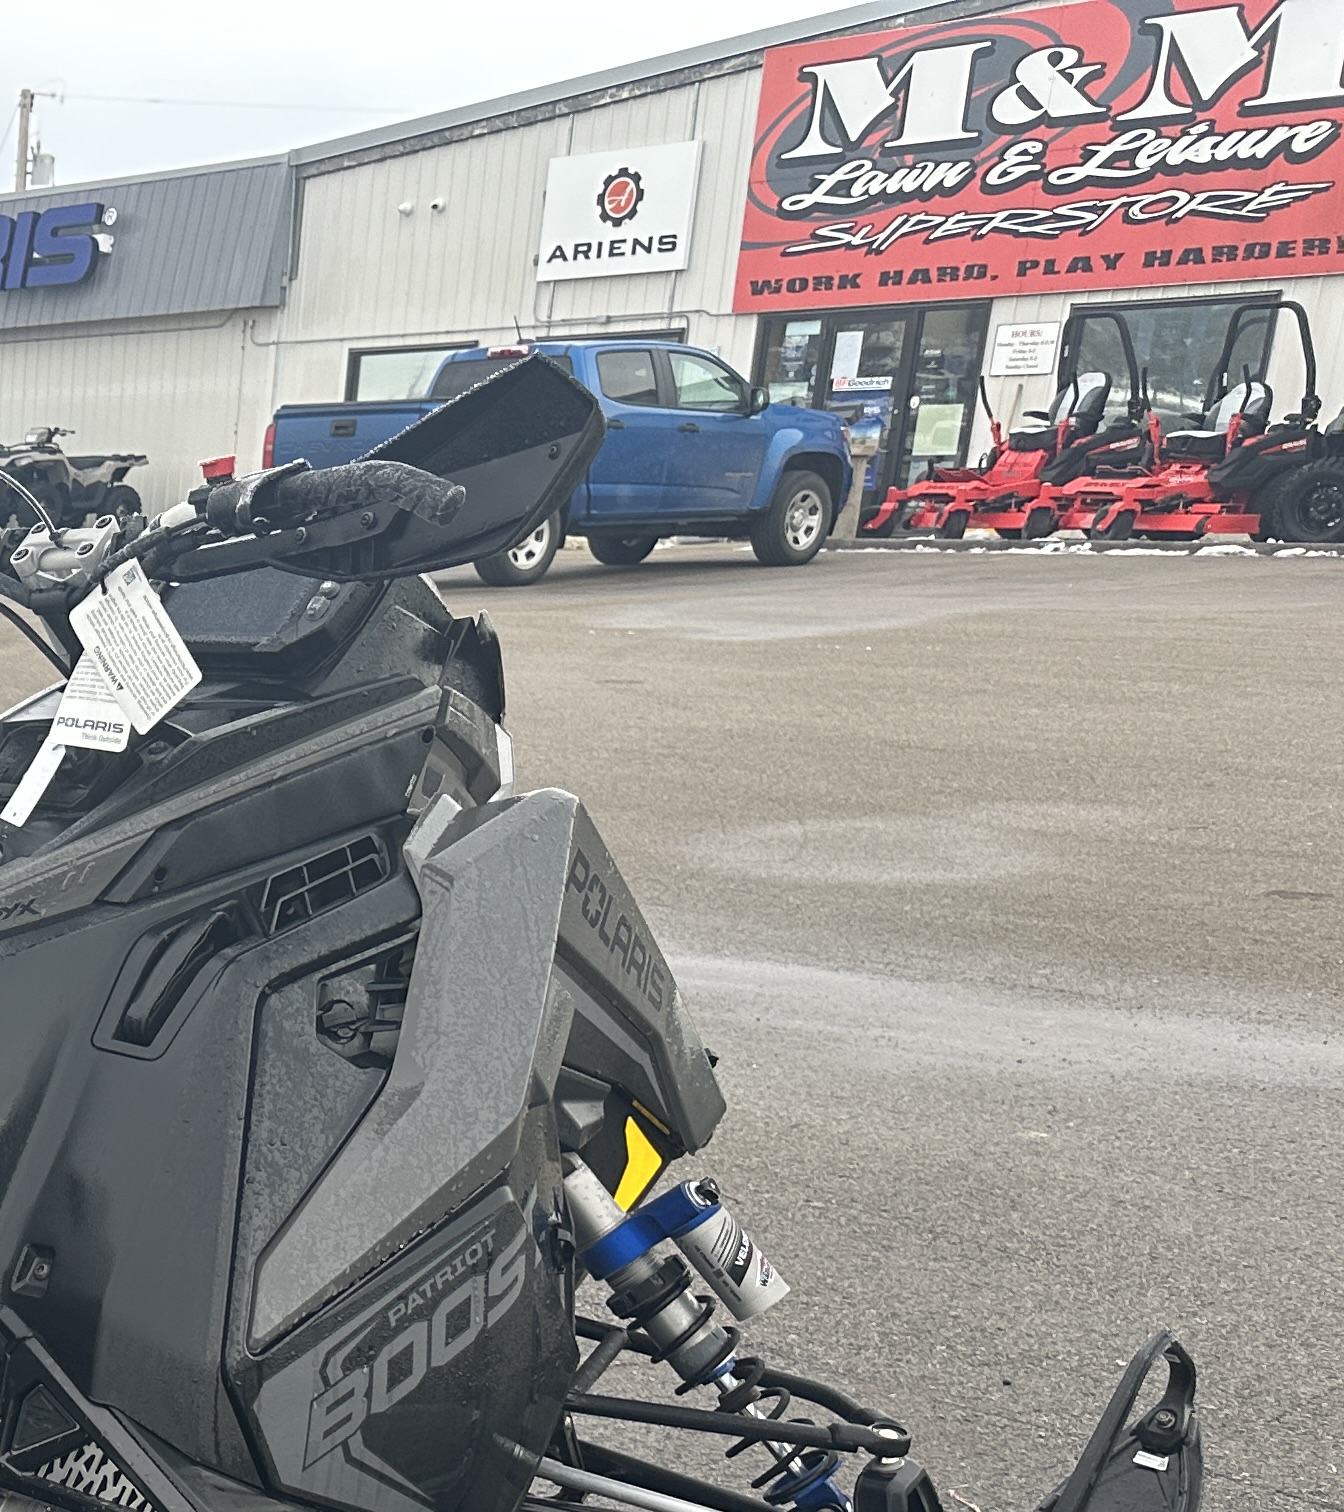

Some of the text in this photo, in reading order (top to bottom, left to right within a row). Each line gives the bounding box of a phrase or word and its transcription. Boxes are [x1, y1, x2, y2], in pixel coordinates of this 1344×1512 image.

[782, 118, 1336, 212] Lawn & Leisure
[545, 233, 679, 264] ARIENS
[784, 182, 1334, 252] SUPERSTORE
[749, 271, 862, 296] WORK
[878, 261, 999, 288] HARD,
[1016, 251, 1126, 278] PLAY
[93, 645, 118, 685] WARNING
[56, 715, 125, 734] POLARIS
[564, 846, 665, 1012] POLARIS
[386, 1228, 496, 1329] PATRIOT
[302, 1221, 542, 1471] BOOS
